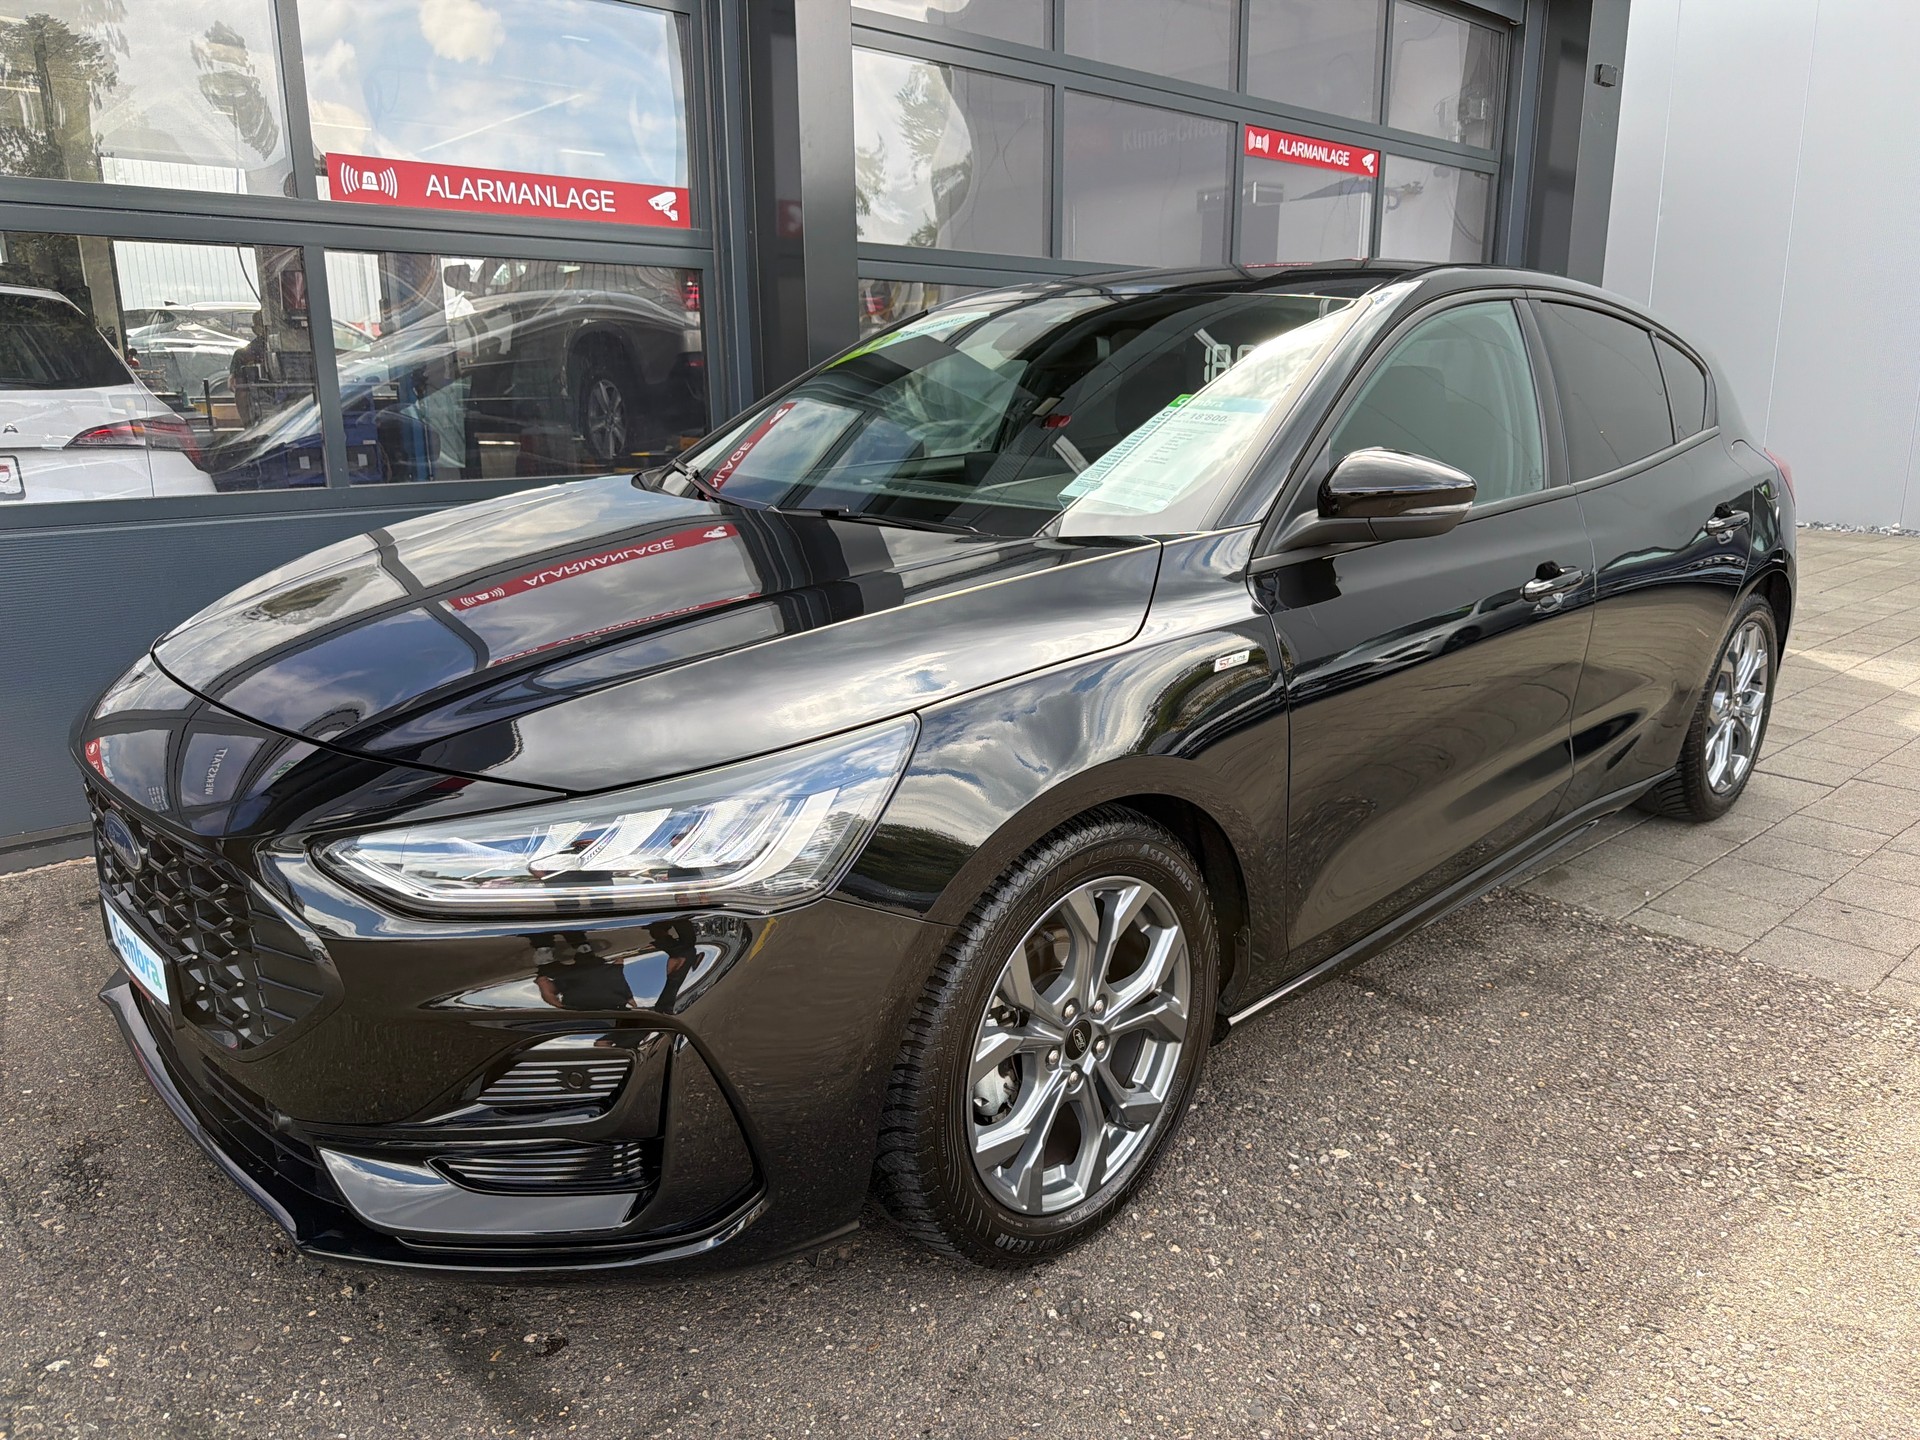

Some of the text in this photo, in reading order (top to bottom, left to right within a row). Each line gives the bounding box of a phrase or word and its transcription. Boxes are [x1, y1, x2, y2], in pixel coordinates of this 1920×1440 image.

[1277, 138, 1350, 167] ALARMANLAGE
[425, 174, 616, 212] ALARMANLAGE
[112, 914, 163, 990] Cembra
